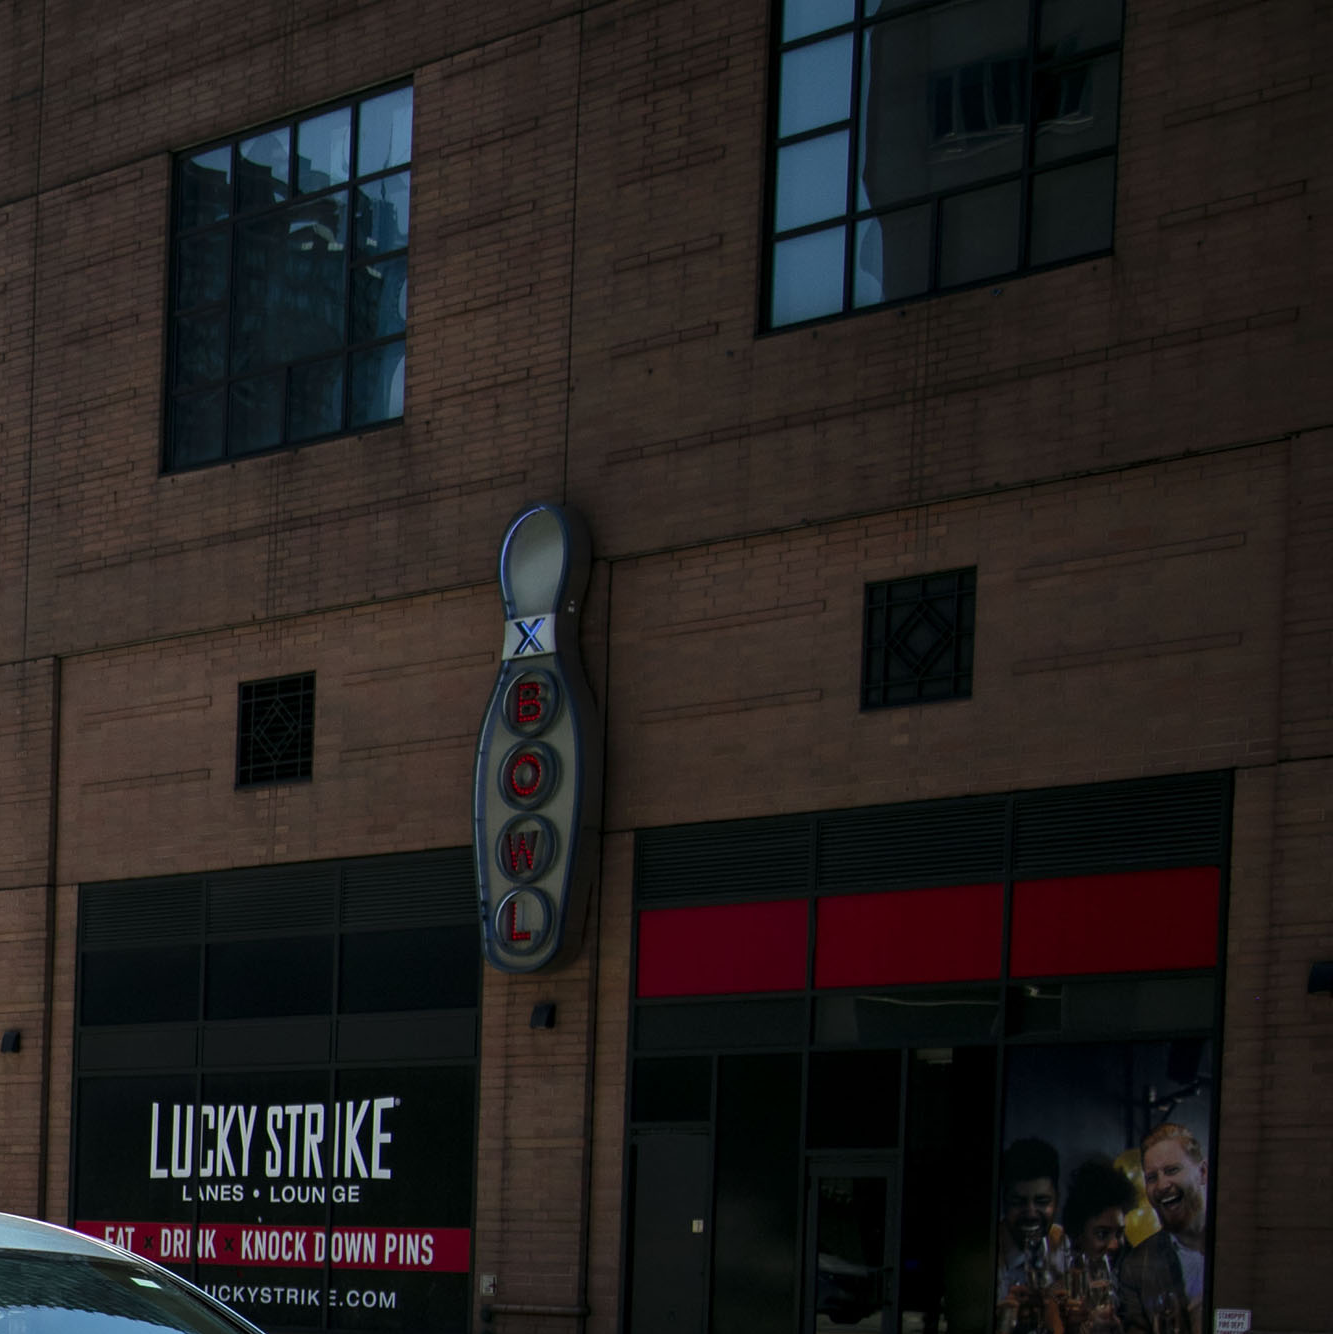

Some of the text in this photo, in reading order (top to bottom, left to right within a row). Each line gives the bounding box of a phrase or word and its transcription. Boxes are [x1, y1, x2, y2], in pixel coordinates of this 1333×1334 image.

[507, 682, 541, 943] BOWL
[150, 1097, 395, 1180] LUCKY STRIKE
[270, 1185, 360, 1204] LOUNGE
[161, 1228, 217, 1259] DRINK
[240, 1231, 307, 1262] KNOCK
[314, 1232, 376, 1265] DOWN
[384, 1233, 435, 1266] PINS
[206, 1285, 397, 1310] UCKYSTRIKE.COM
